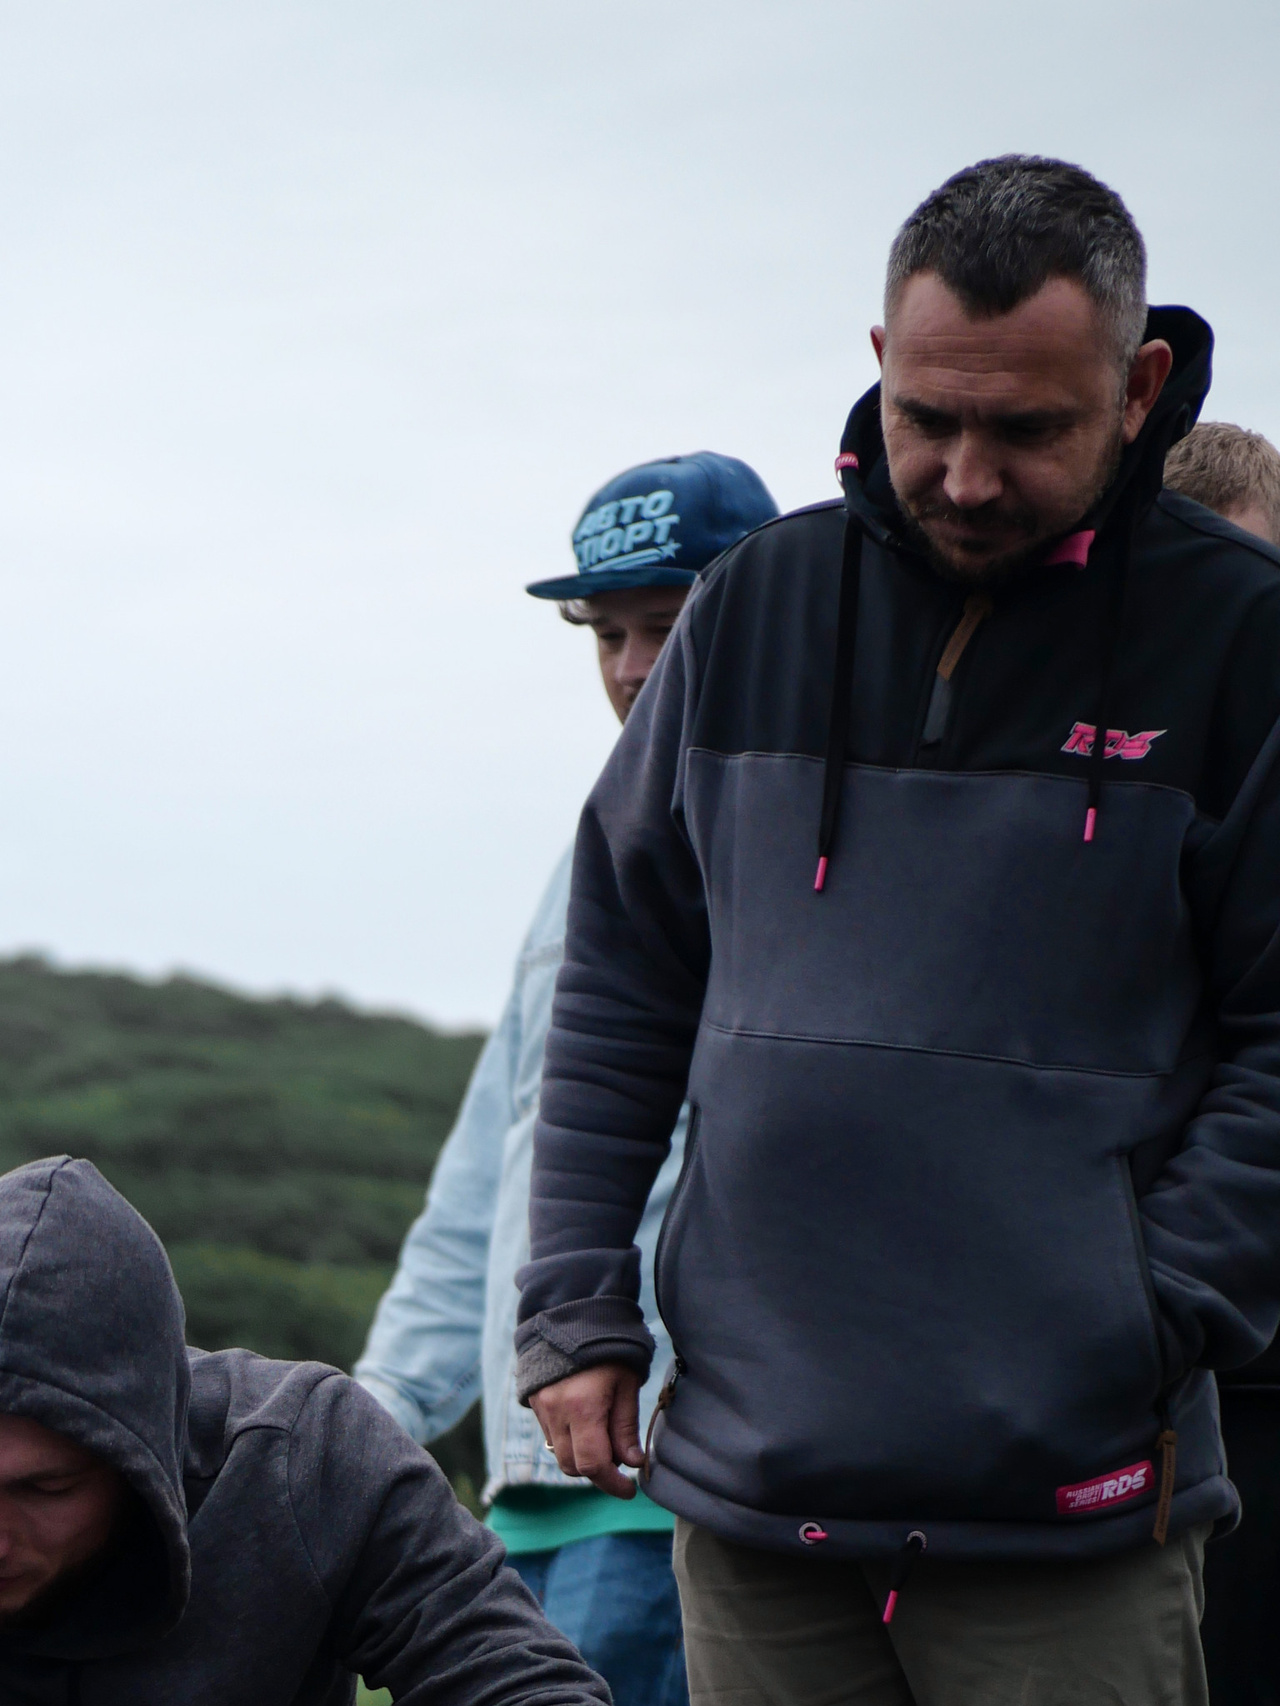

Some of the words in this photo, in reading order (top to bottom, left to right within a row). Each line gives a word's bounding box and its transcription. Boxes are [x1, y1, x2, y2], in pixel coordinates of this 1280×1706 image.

[574, 514, 681, 570] ПОРТ
[1060, 721, 1168, 760] RDS
[1066, 1485, 1100, 1498] RUSSIAN
[1101, 1467, 1148, 1500] RDS
